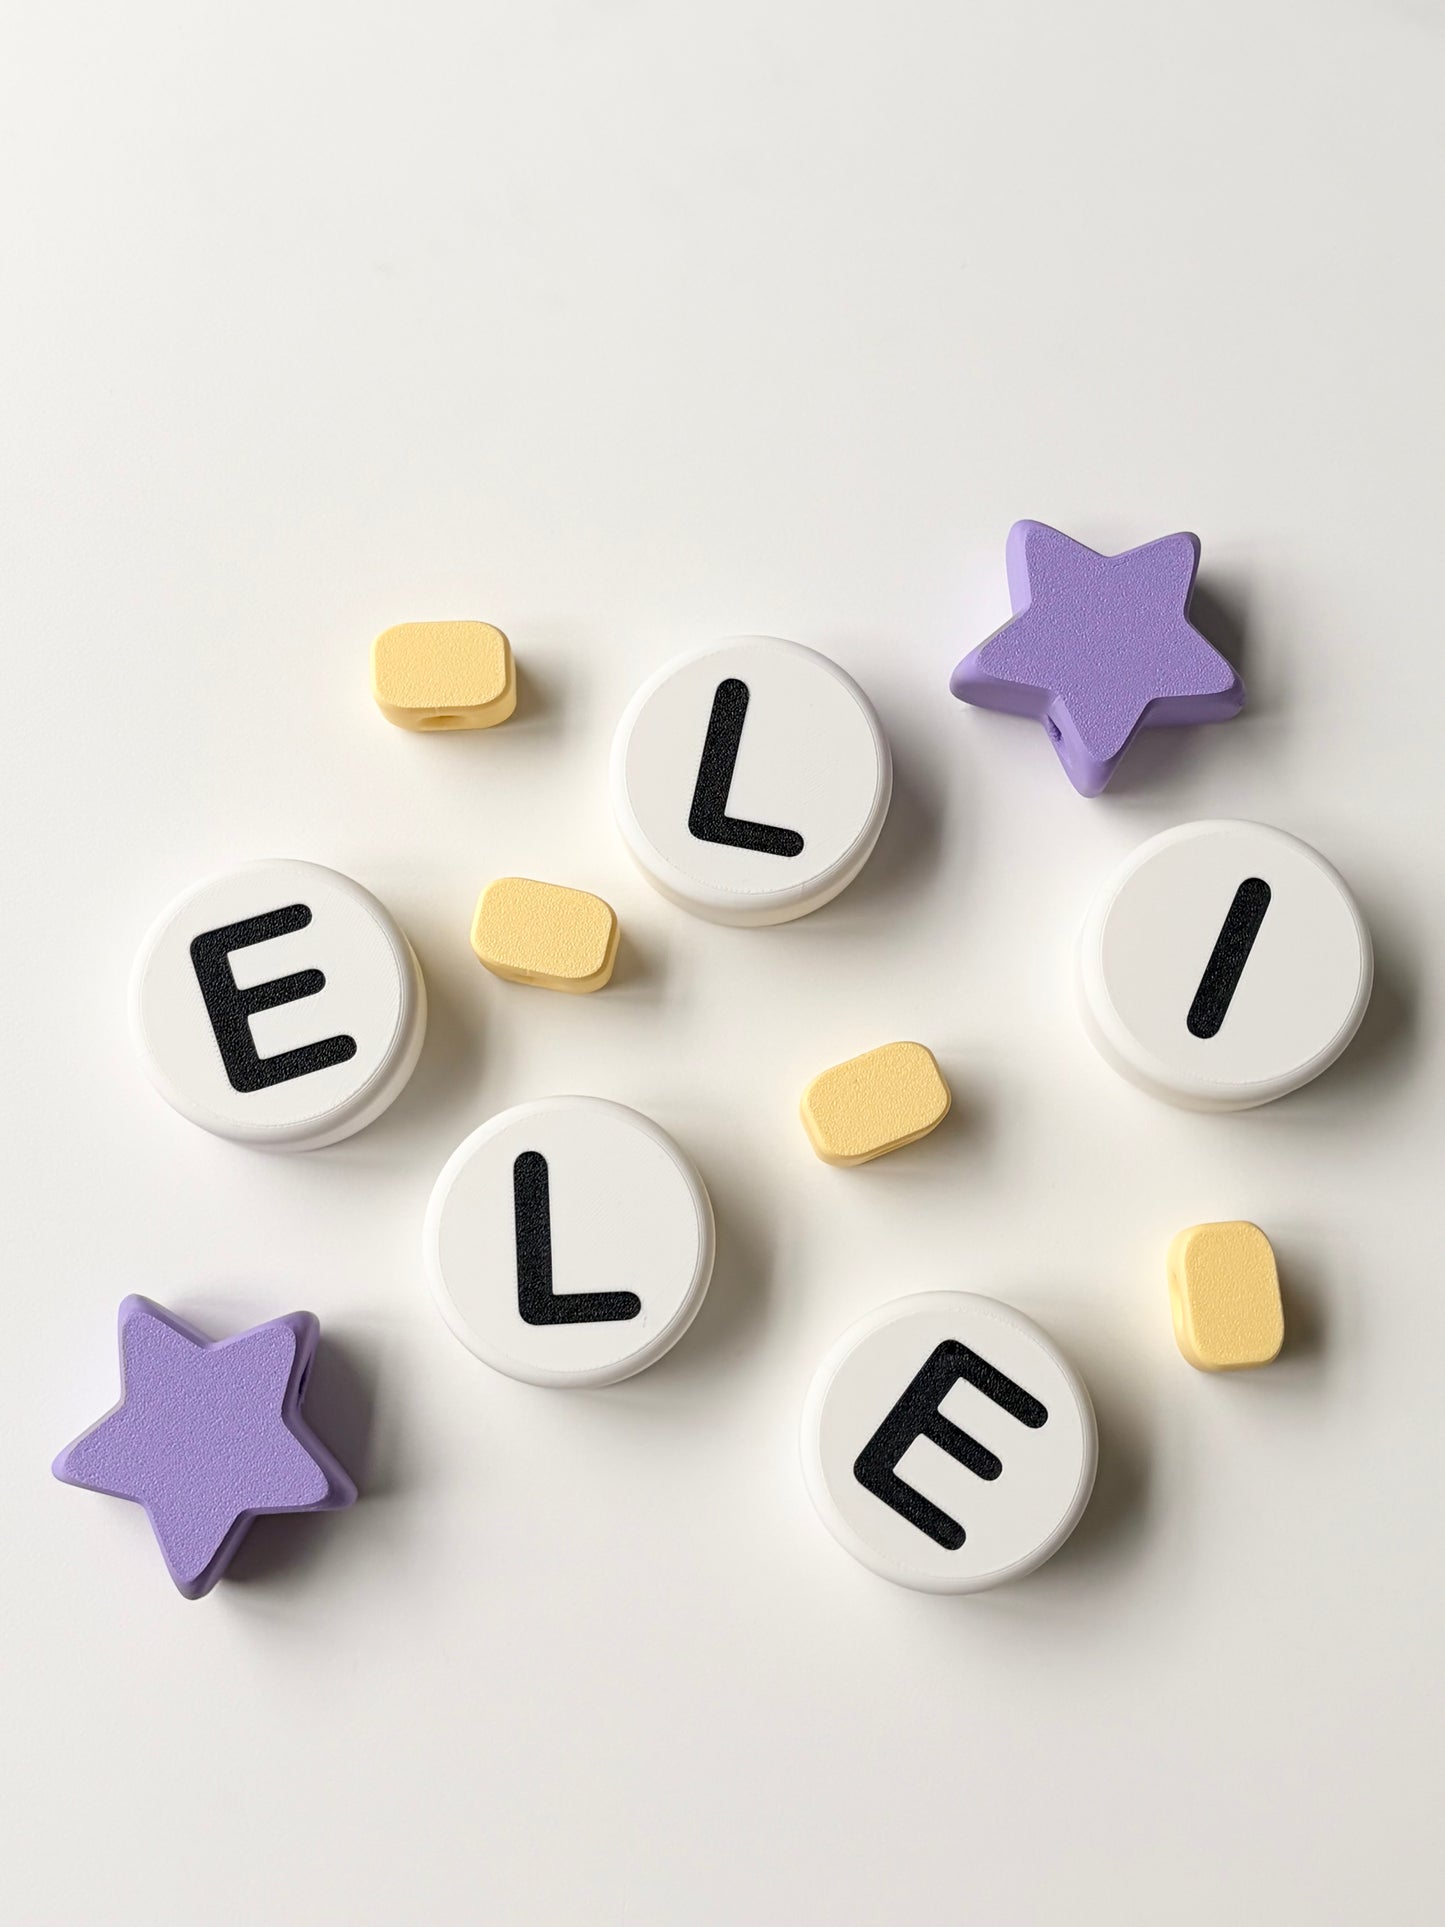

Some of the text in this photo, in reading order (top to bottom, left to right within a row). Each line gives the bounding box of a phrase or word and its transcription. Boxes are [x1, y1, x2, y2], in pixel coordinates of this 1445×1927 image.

[688, 678, 805, 858] L
[189, 903, 357, 1093] E
[1186, 877, 1272, 1040] I
[513, 1150, 642, 1326] L
[853, 1339, 1049, 1551] E
